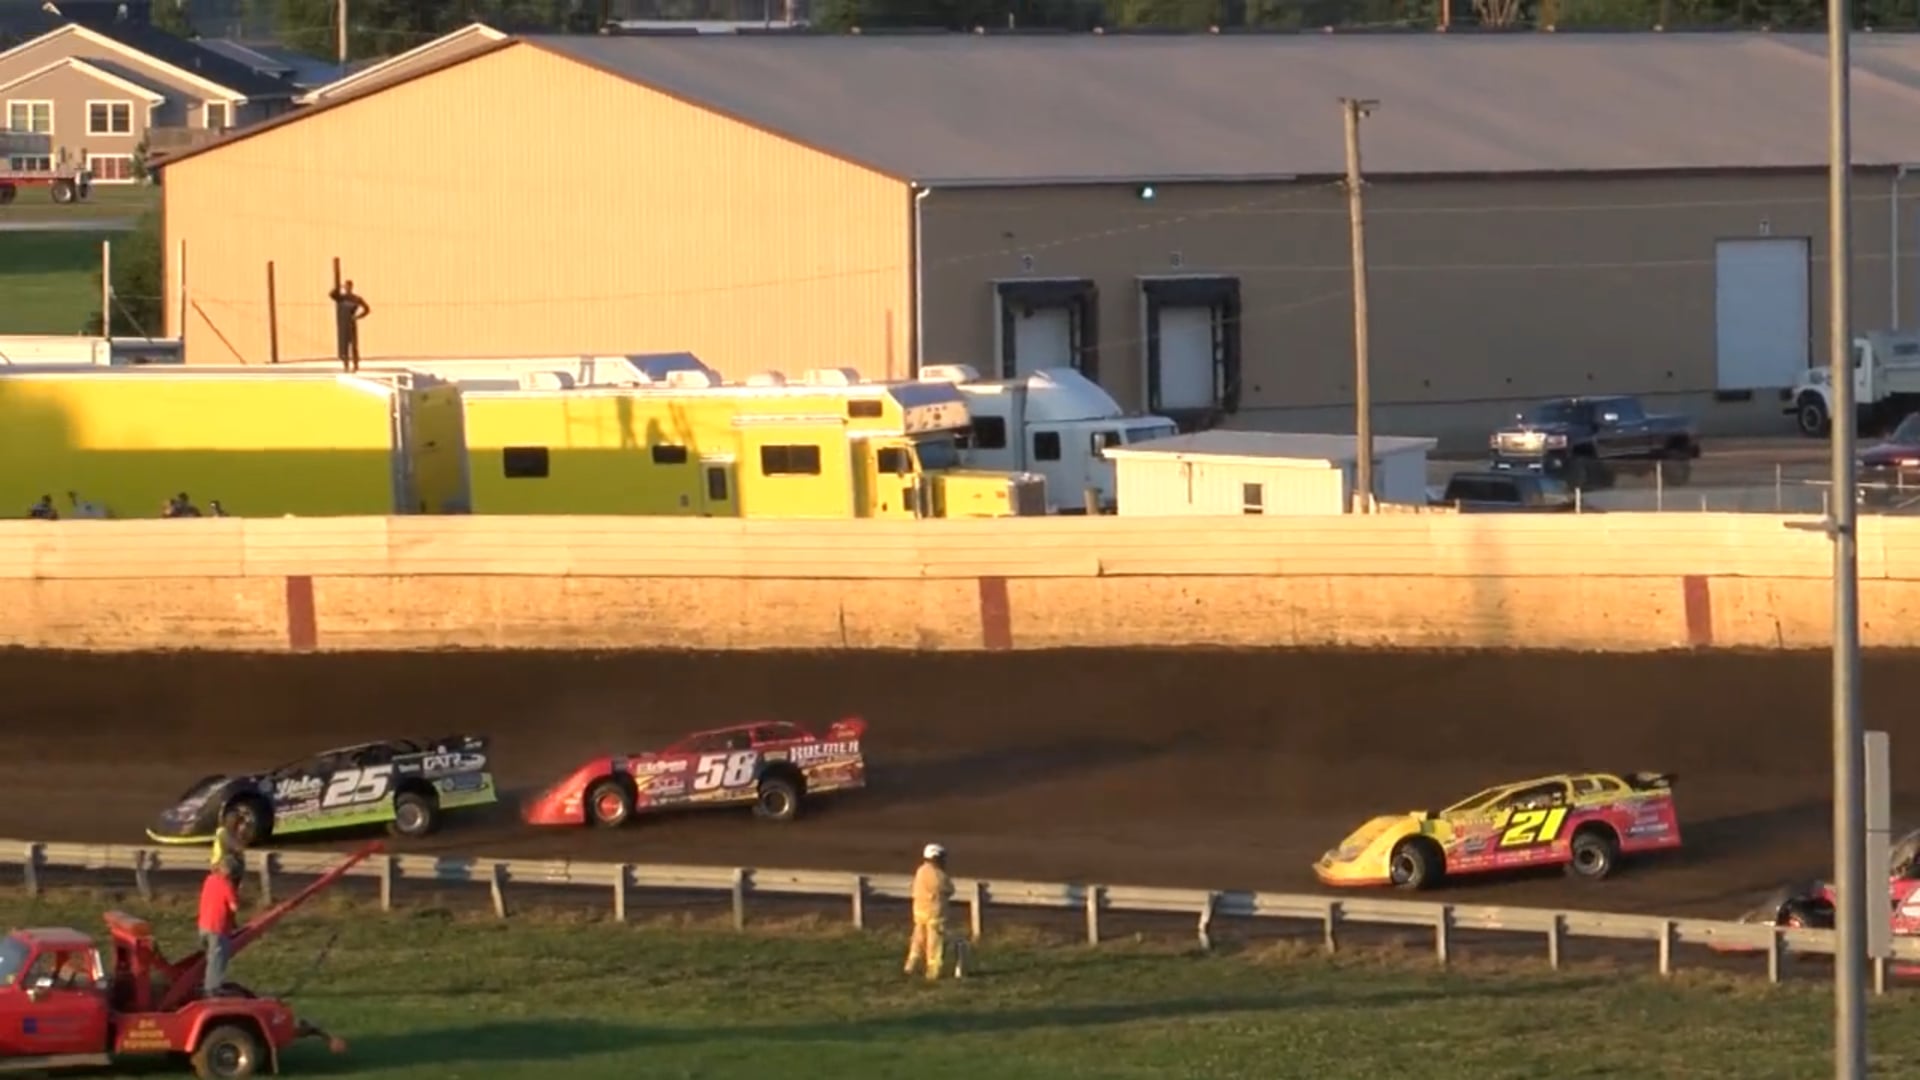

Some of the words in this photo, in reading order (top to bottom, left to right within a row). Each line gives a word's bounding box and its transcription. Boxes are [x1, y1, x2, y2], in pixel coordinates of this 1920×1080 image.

[321, 764, 393, 808] 25
[693, 751, 758, 790] 58
[1500, 808, 1568, 847] 21
